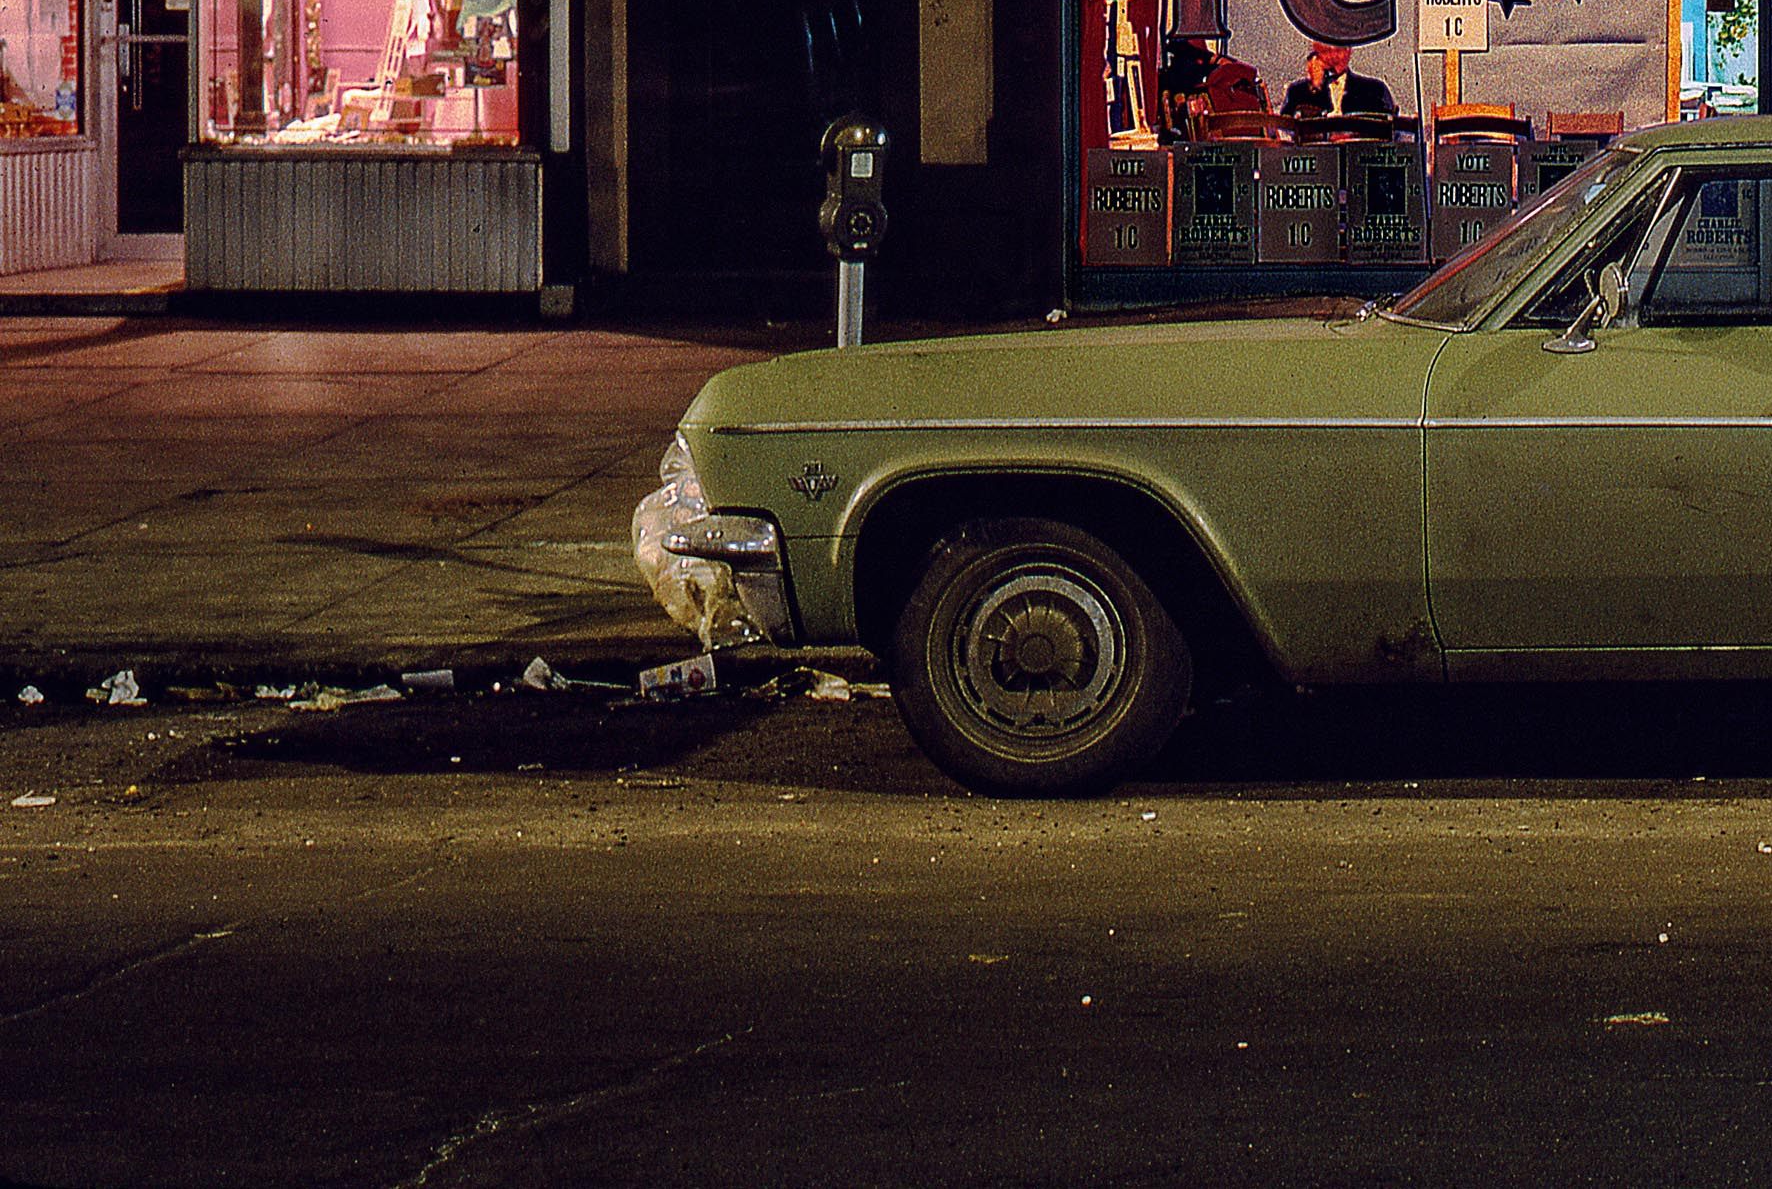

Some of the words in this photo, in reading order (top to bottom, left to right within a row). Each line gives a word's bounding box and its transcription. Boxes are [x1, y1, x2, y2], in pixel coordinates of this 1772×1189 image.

[1112, 158, 1147, 176] VOTE
[1283, 156, 1317, 172] VOTE
[1455, 154, 1491, 171] VOTE
[1092, 186, 1163, 212] ROBERTS
[1265, 185, 1334, 210] ROBERTS
[1438, 182, 1507, 207] ROBERTS
[1180, 226, 1249, 242] ROBERTS
[1353, 226, 1421, 242] ROBERTS
[1686, 229, 1752, 245] ROBERTS
